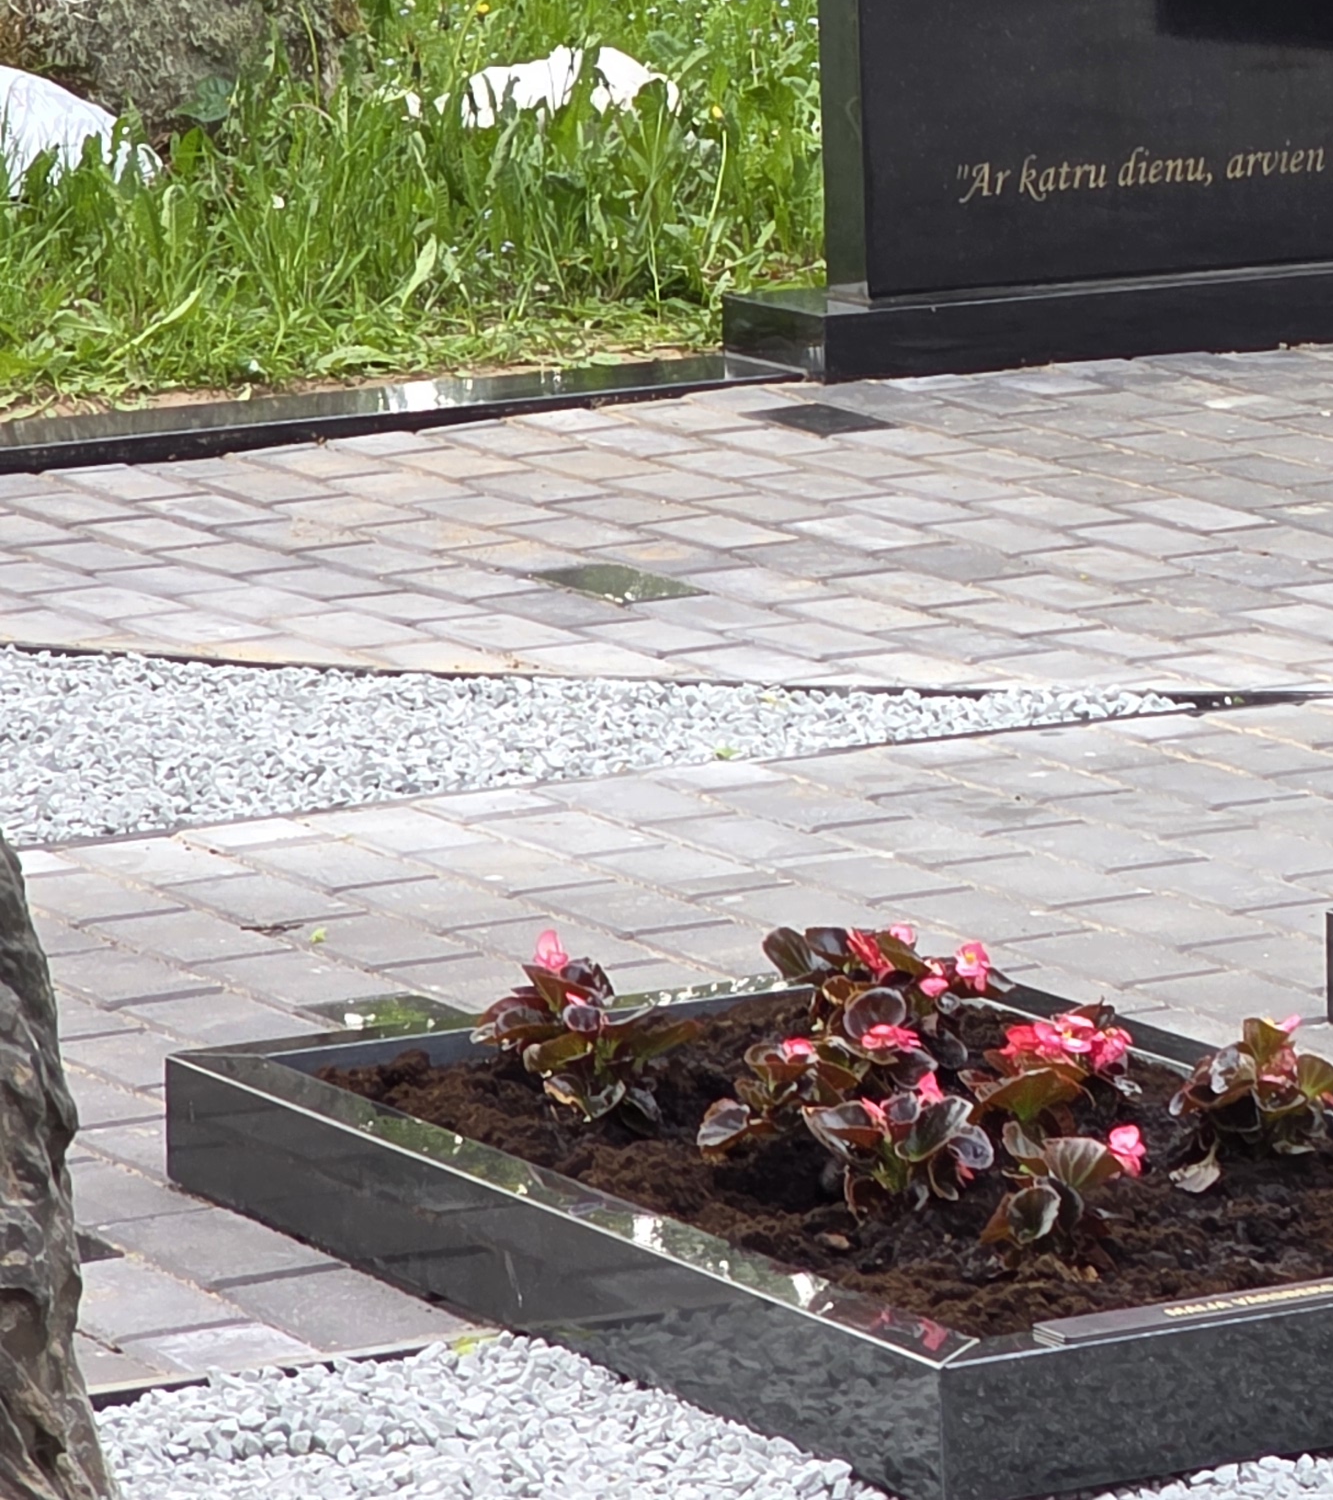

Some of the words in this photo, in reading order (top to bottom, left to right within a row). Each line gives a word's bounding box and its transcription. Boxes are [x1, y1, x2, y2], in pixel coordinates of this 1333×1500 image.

[1019, 154, 1107, 202] katru
[1118, 146, 1213, 187] dienu,
[1226, 139, 1326, 179] arvien
